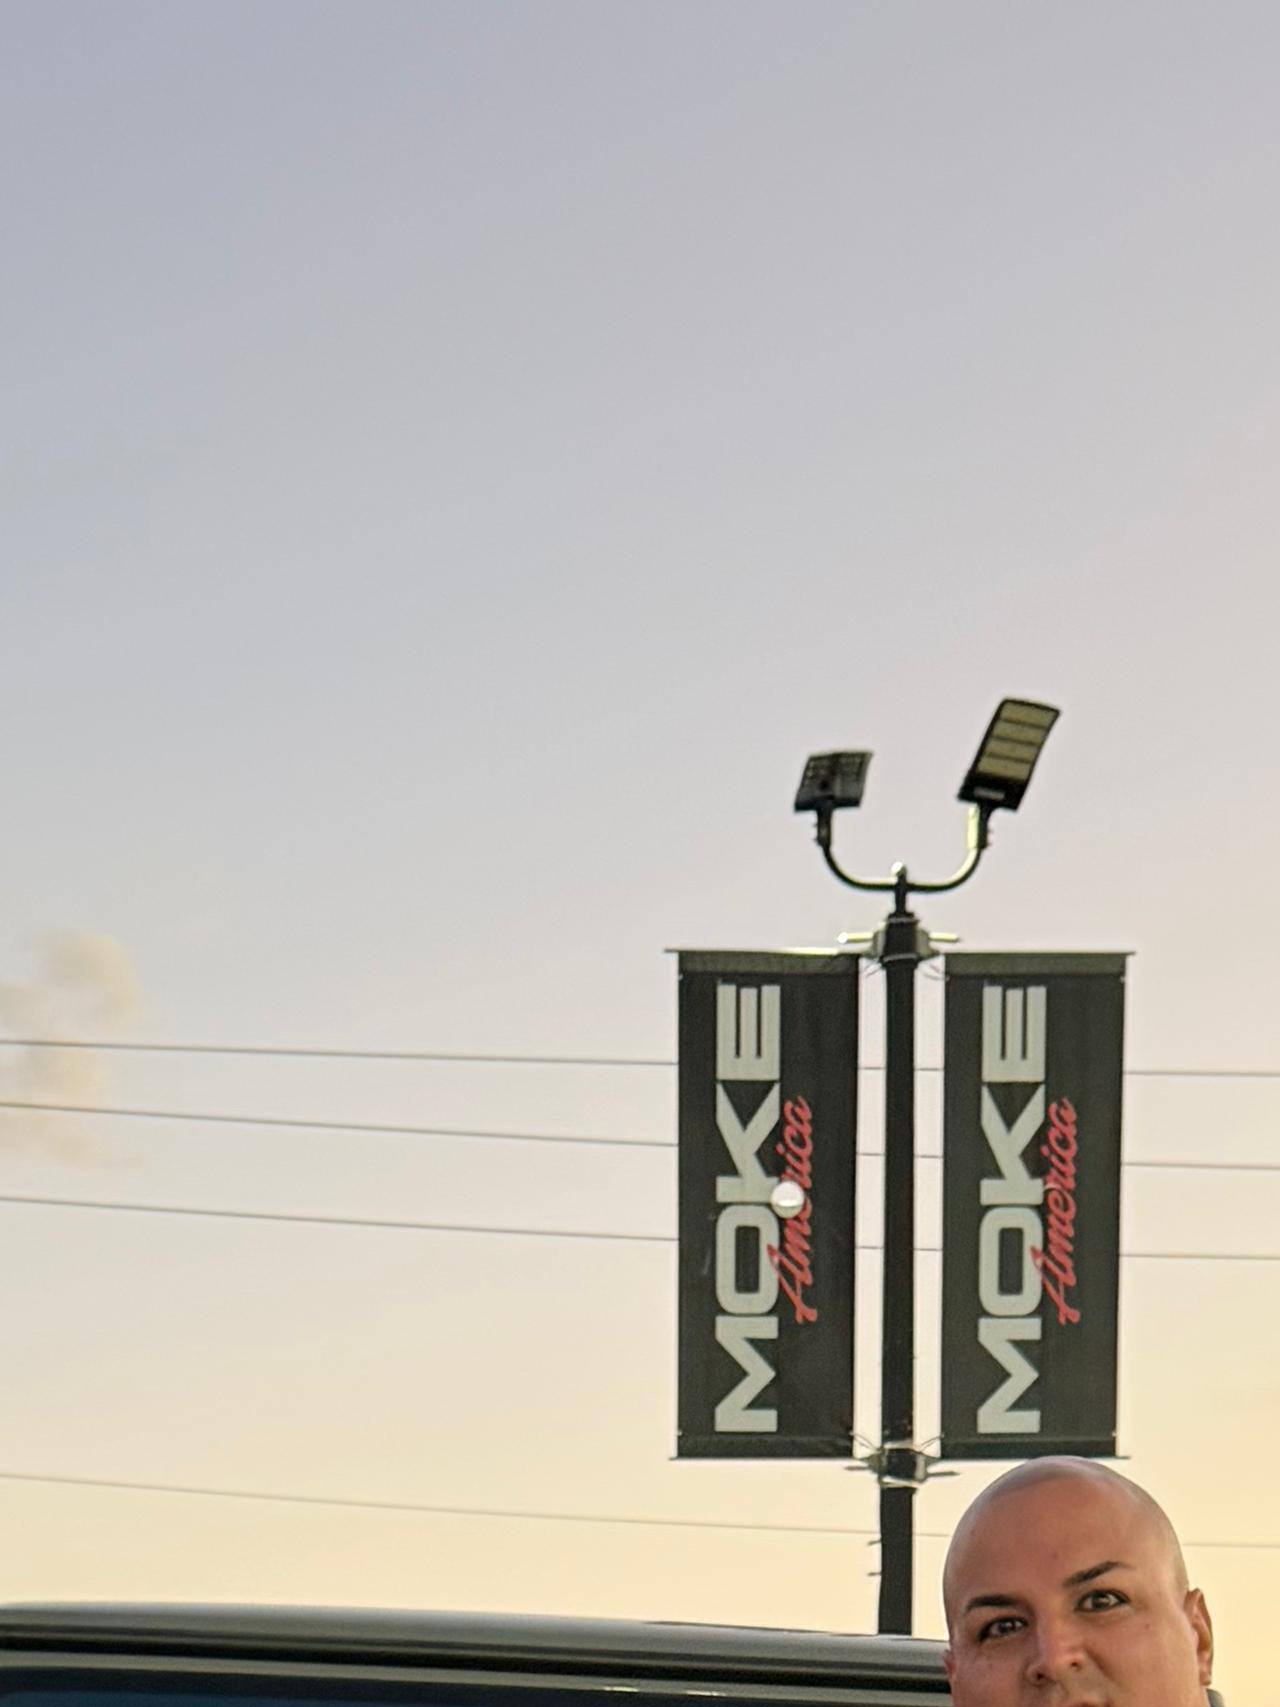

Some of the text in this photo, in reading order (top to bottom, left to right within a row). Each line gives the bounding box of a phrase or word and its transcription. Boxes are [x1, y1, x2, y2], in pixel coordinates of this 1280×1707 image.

[715, 984, 781, 1433] MOKE
[977, 985, 1047, 1434] MOKE
[1031, 1098, 1081, 1326] America
